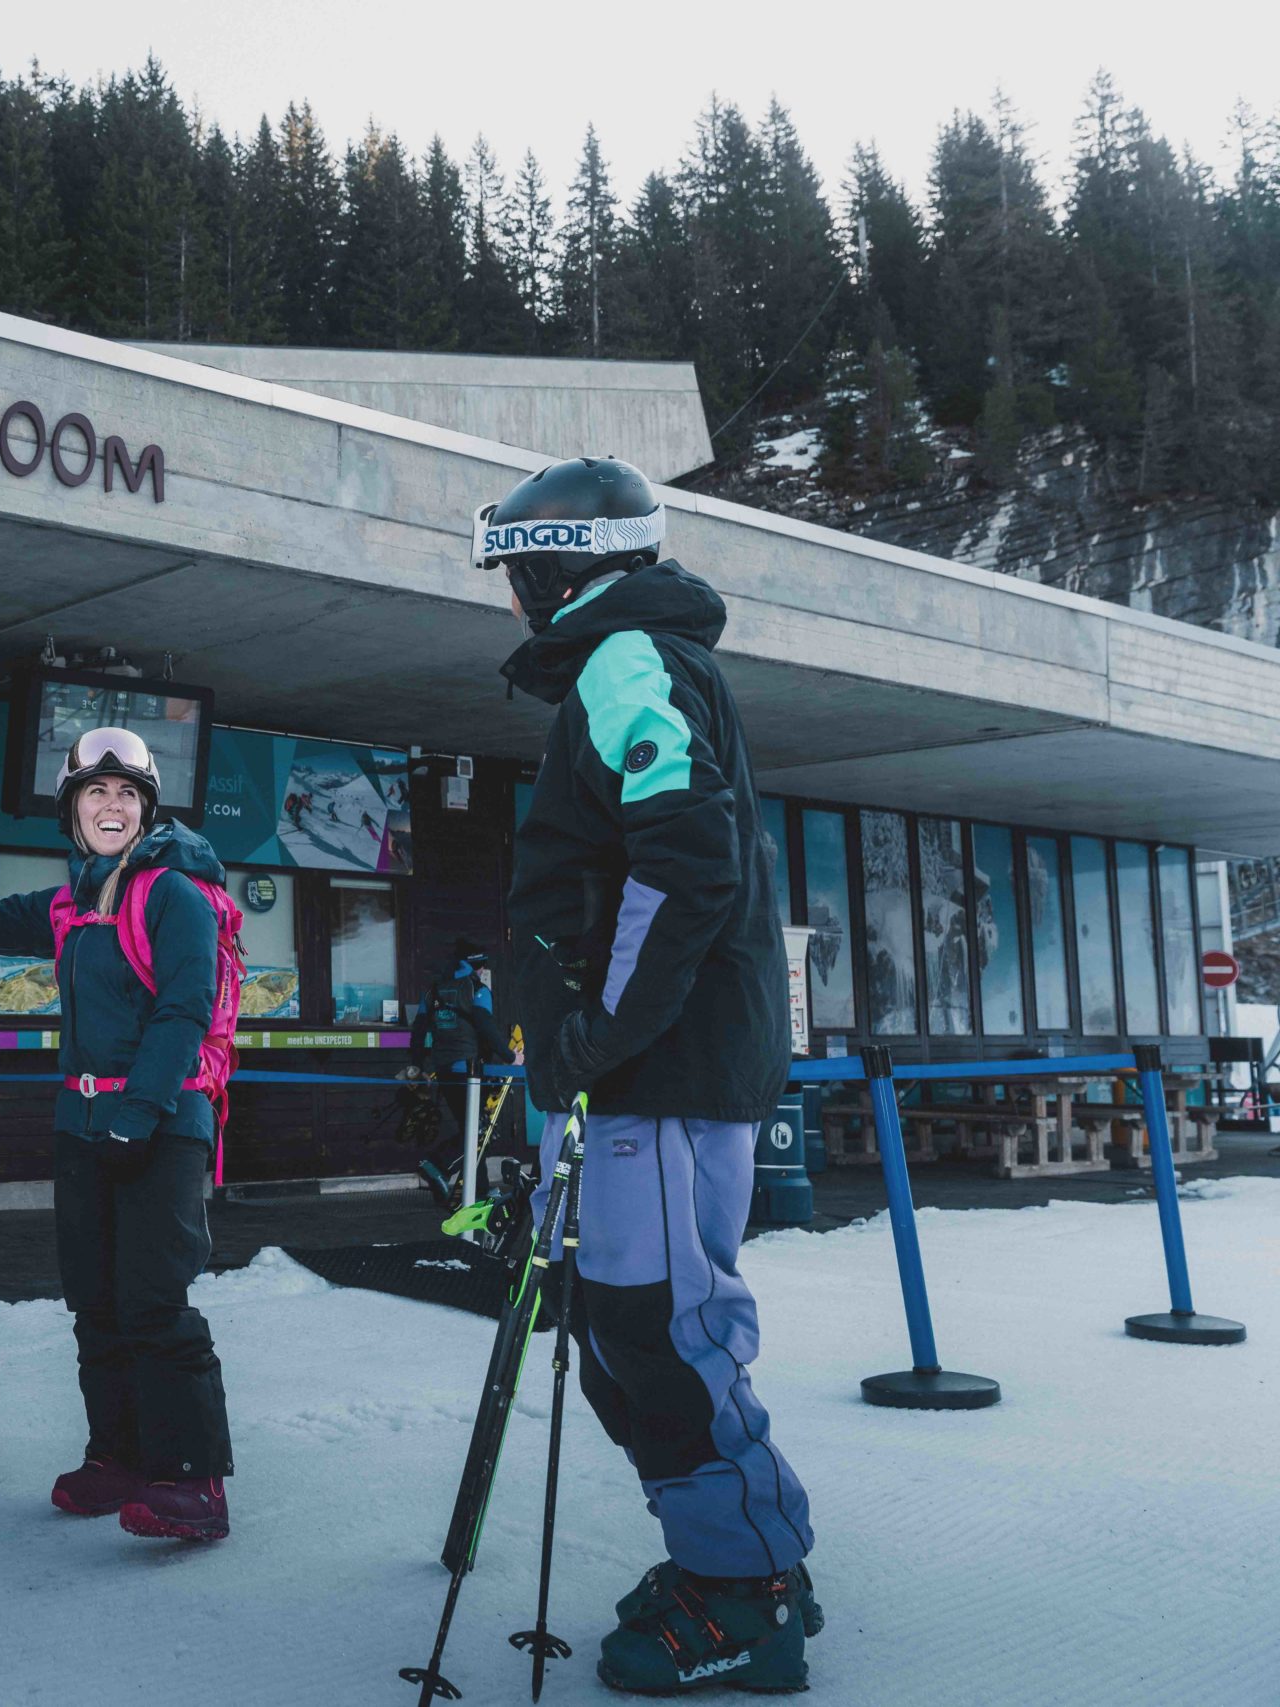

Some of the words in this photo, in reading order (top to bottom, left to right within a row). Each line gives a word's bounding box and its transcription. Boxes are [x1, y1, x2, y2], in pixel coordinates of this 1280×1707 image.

[287, 1036, 303, 1045] meet
[303, 1036, 314, 1045] the
[314, 1035, 353, 1045] UNEXPECTED
[678, 1651, 751, 1683] LANGE
